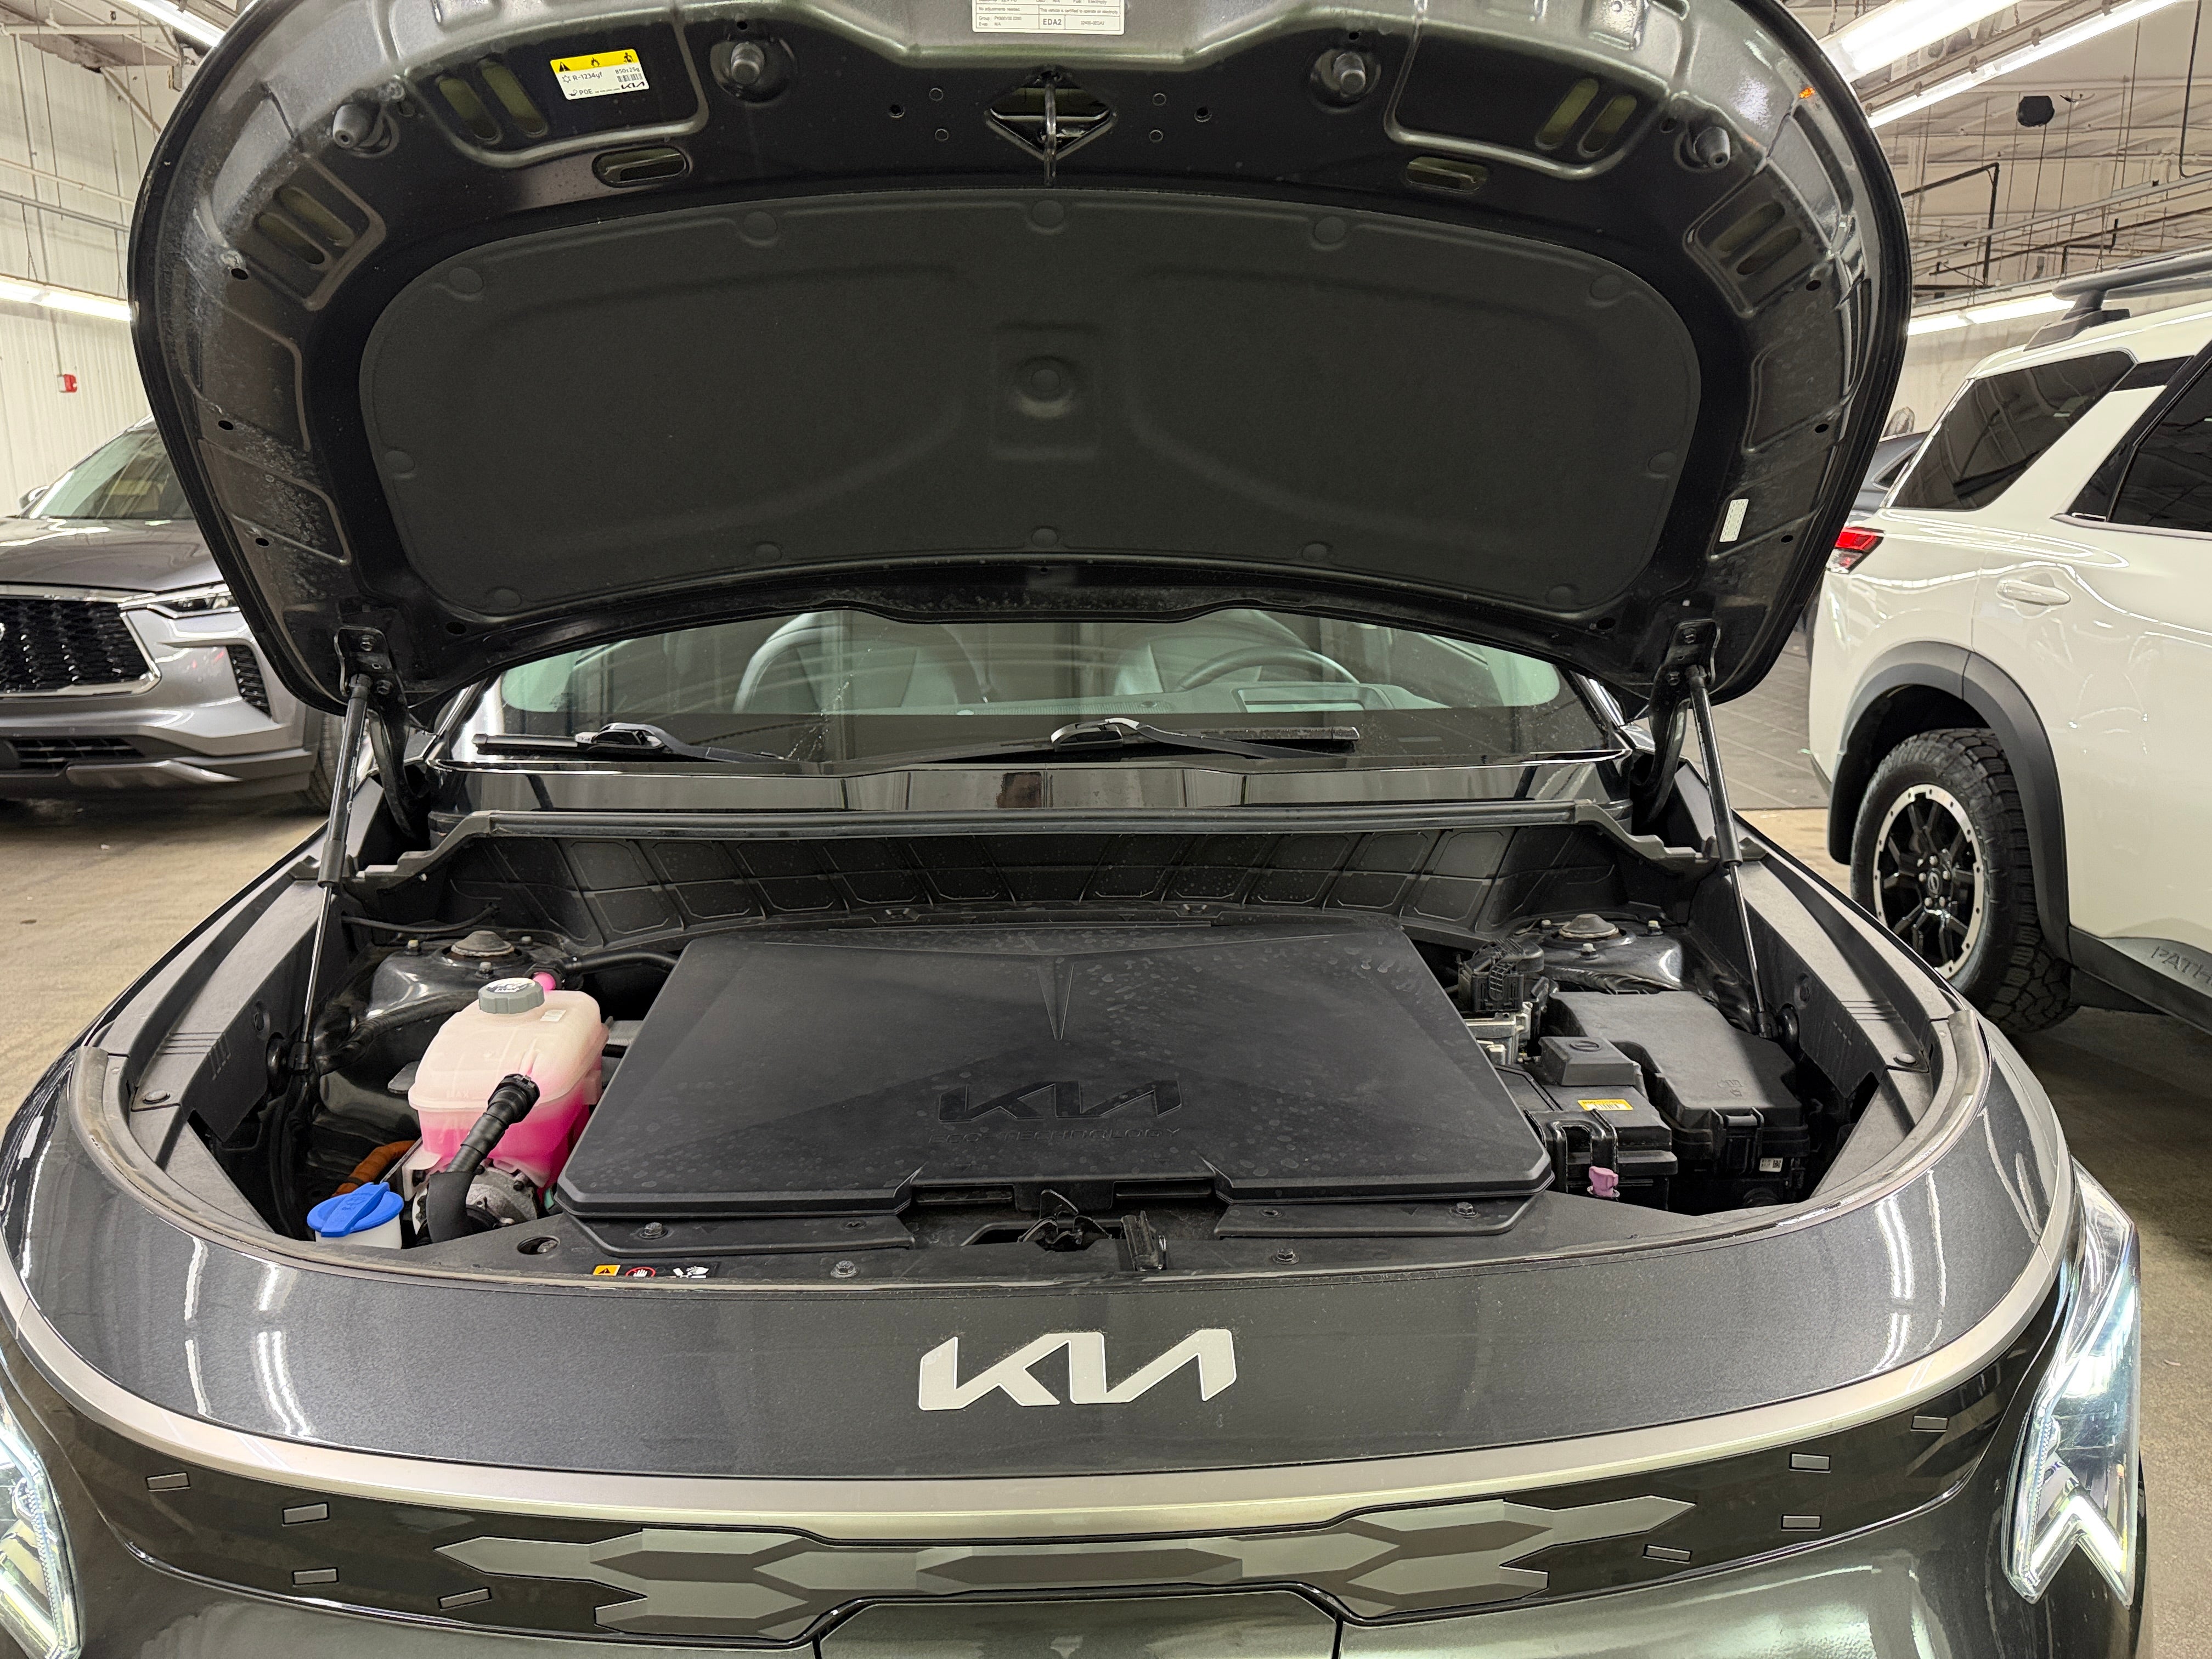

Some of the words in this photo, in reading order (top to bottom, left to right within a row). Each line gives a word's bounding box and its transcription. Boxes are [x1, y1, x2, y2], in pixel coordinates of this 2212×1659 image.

[572, 71, 602, 81] R-1234yf
[620, 81, 645, 89] KIA
[2151, 946, 2212, 986] PATH
[939, 1080, 1182, 1123] KIA
[918, 1329, 1237, 1411] KIA
